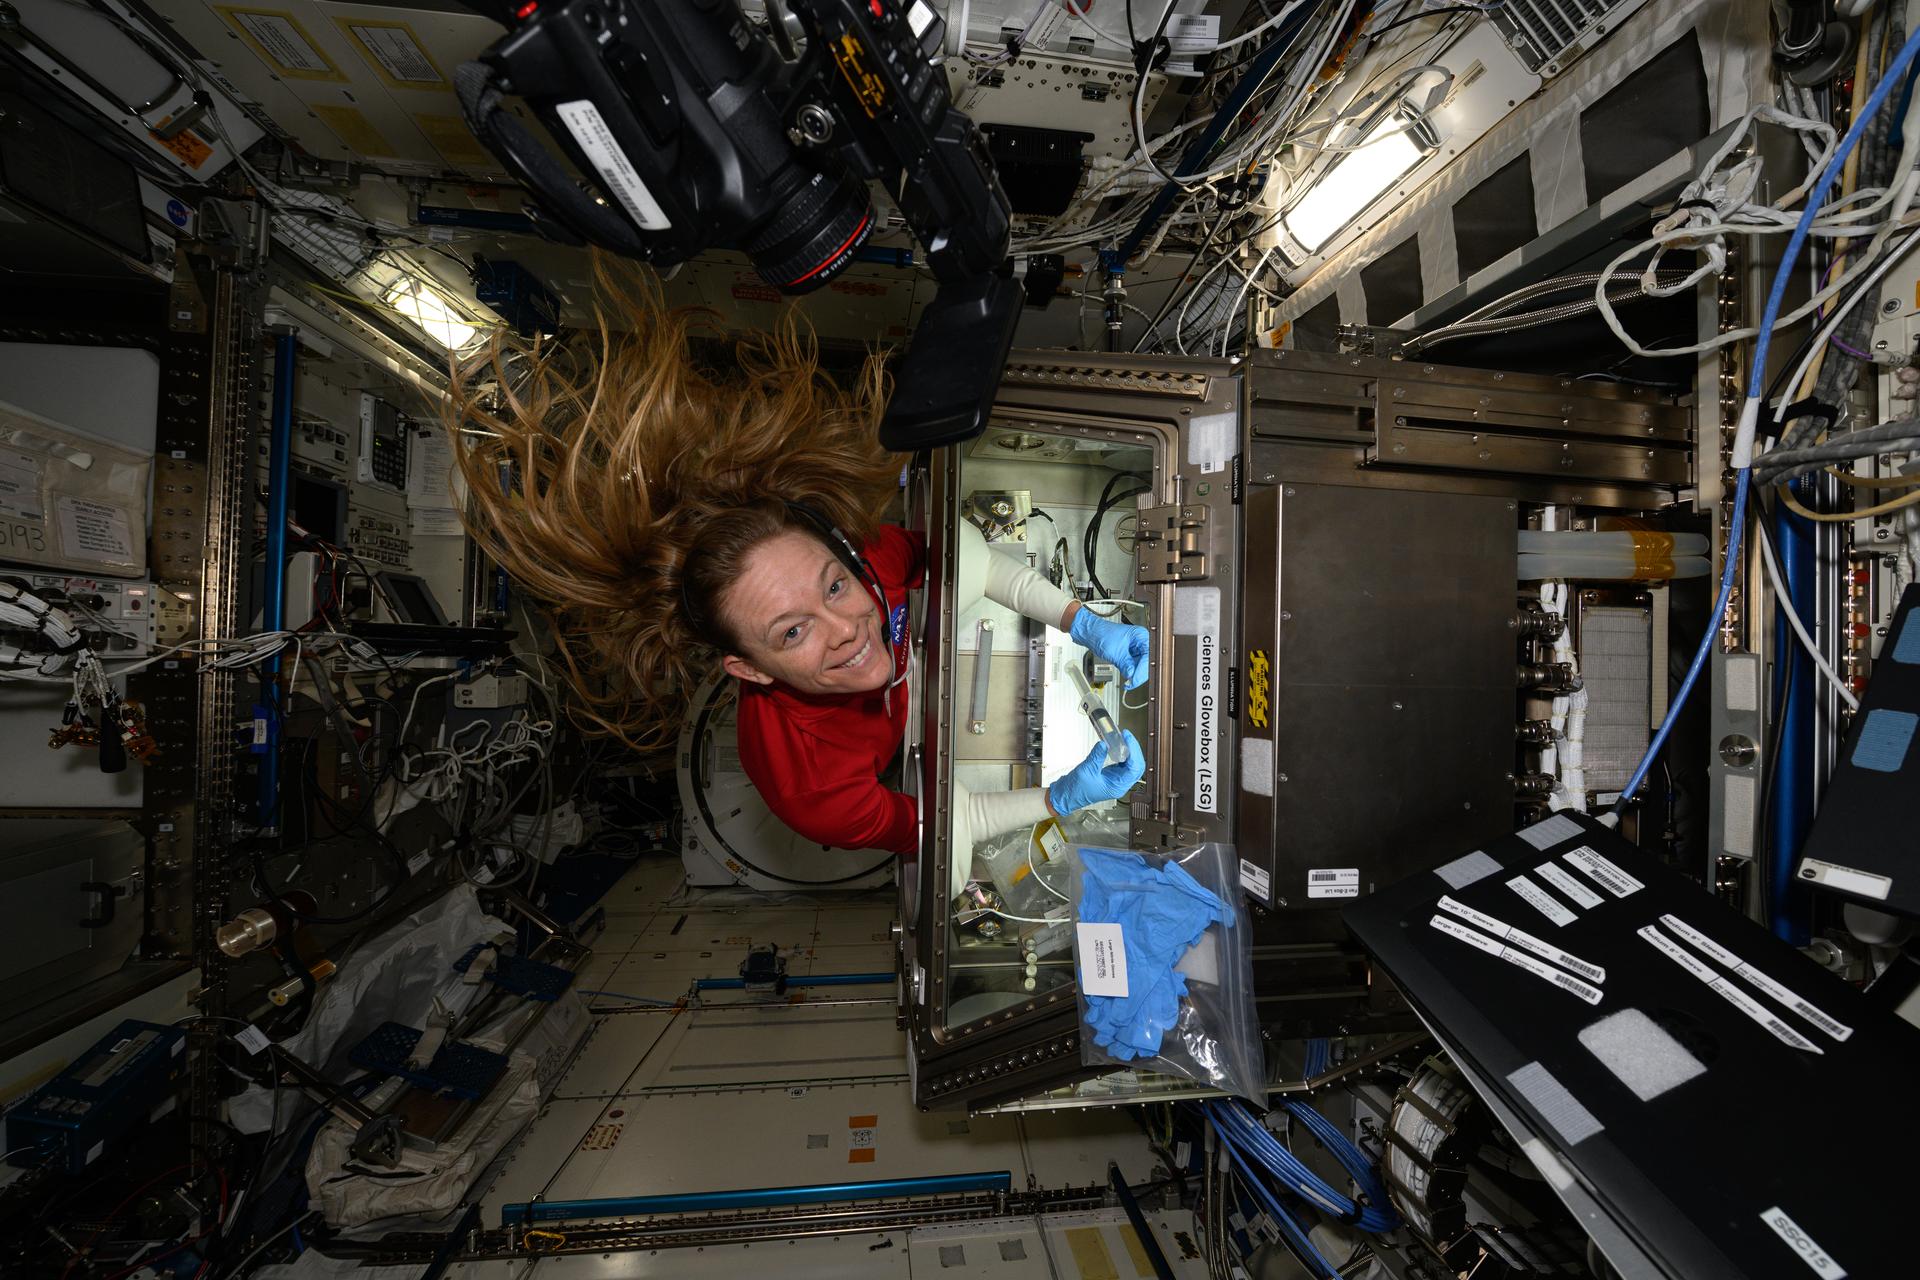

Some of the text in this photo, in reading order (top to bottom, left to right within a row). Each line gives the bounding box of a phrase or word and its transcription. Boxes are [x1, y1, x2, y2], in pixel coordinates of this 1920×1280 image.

[894, 607, 907, 642] NASA
[1200, 695, 1215, 765] Glovebox
[1197, 768, 1213, 811] (LSG)
[1432, 917, 1452, 930] Large
[1464, 932, 1488, 946] Sleeve
[1439, 898, 1459, 911] Large
[1471, 913, 1494, 927] Sleeve
[1642, 927, 1669, 948] Medium
[1678, 953, 1702, 973] Sleeve
[1662, 915, 1690, 936] Medium
[1700, 940, 1726, 959] Sleeve
[1772, 1214, 1830, 1269] SSC15
